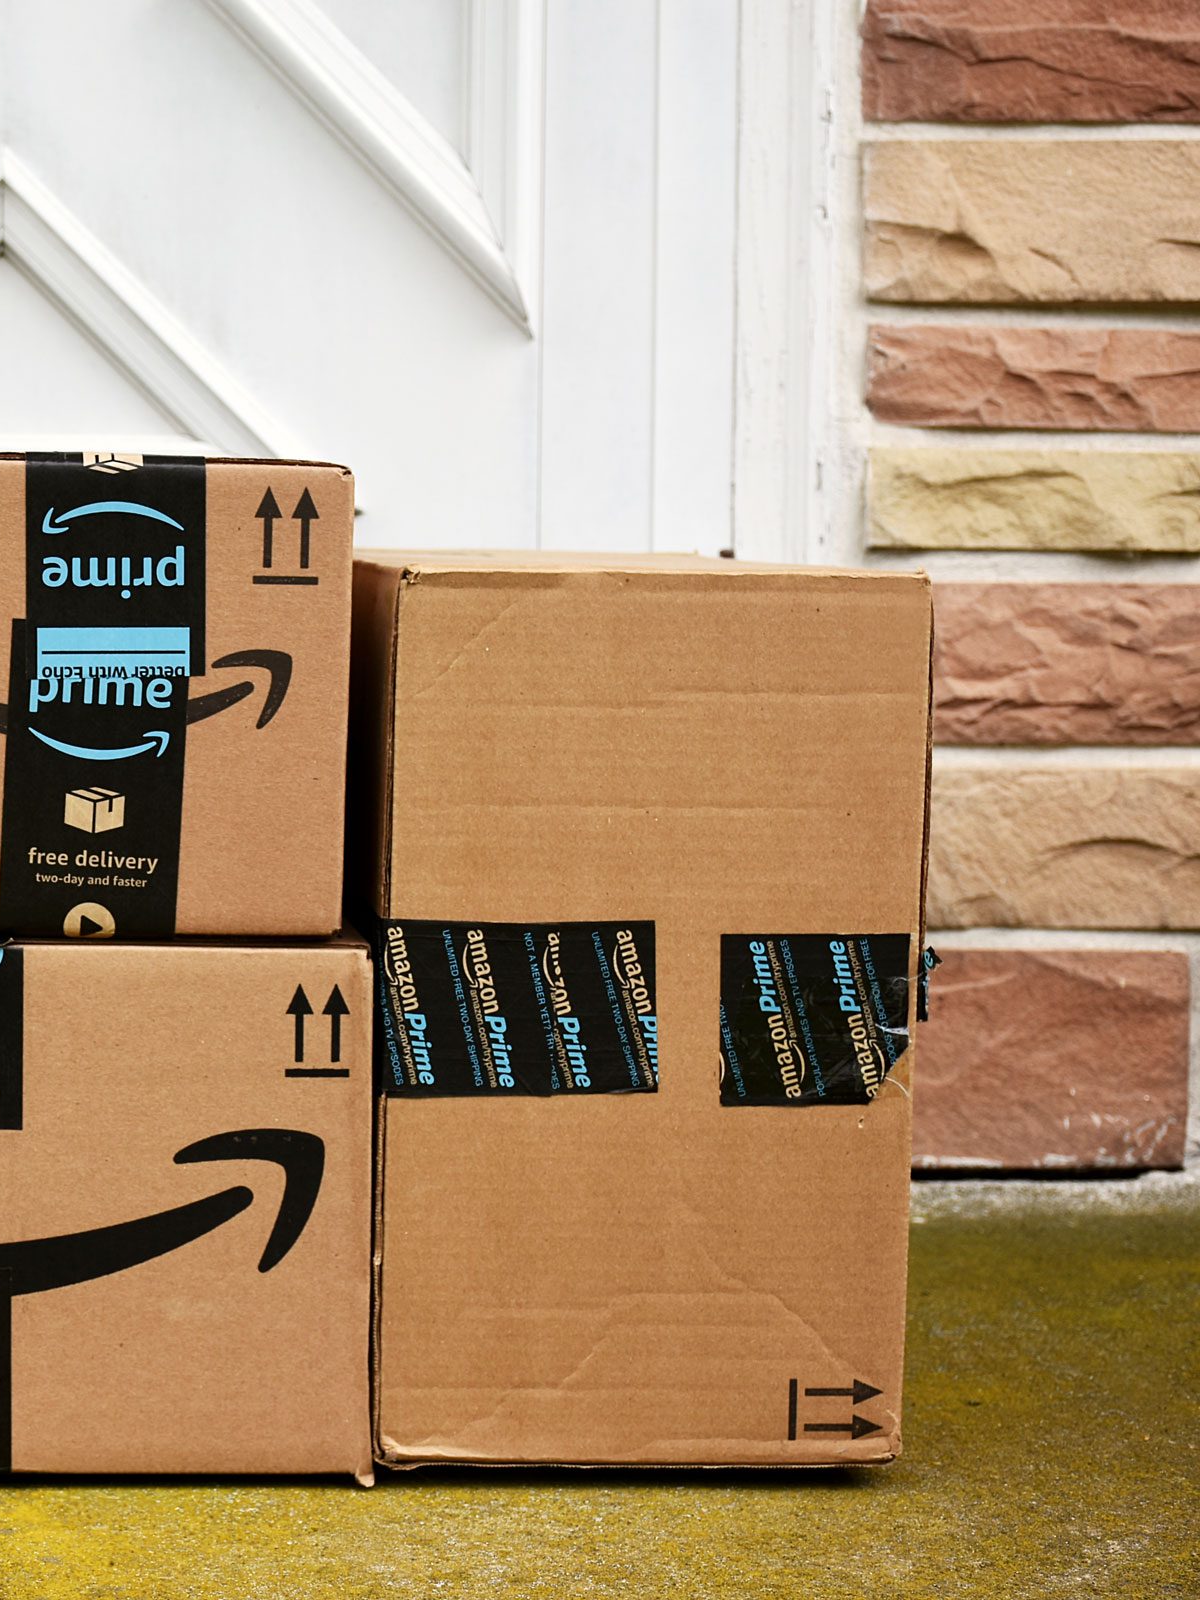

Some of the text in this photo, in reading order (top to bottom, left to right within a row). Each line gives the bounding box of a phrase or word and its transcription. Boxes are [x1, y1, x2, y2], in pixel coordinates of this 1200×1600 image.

[42, 546, 184, 599] prime
[42, 666, 83, 678] Echo
[28, 676, 173, 713] prime
[28, 847, 158, 874] free delivery
[36, 873, 147, 887] two-day and faster
[523, 932, 535, 951] NOT
[528, 954, 536, 962] A
[859, 938, 871, 961] FREE
[530, 963, 546, 1005] MEMBER
[766, 941, 796, 1037] amazon.com/tryprime
[846, 940, 876, 1037] amazon.com/tryprime
[865, 961, 875, 979] FOR
[442, 929, 483, 1086] UNLIMITED FREE TWO-DAY SHIPPING
[540, 1006, 552, 1030] YET?
[592, 932, 640, 1086] UNLIMITED FREE TWO-DAY SHIPPING
[779, 939, 826, 1096] POPULAR MOVIES AND TV EPISODES
[871, 981, 886, 1020] BORROW
[389, 986, 417, 1084] amazon.com/tryprime
[470, 989, 497, 1087] amazon.com/tryprime
[723, 1024, 737, 1049] FREE
[727, 1050, 746, 1097] UNLIMITED
